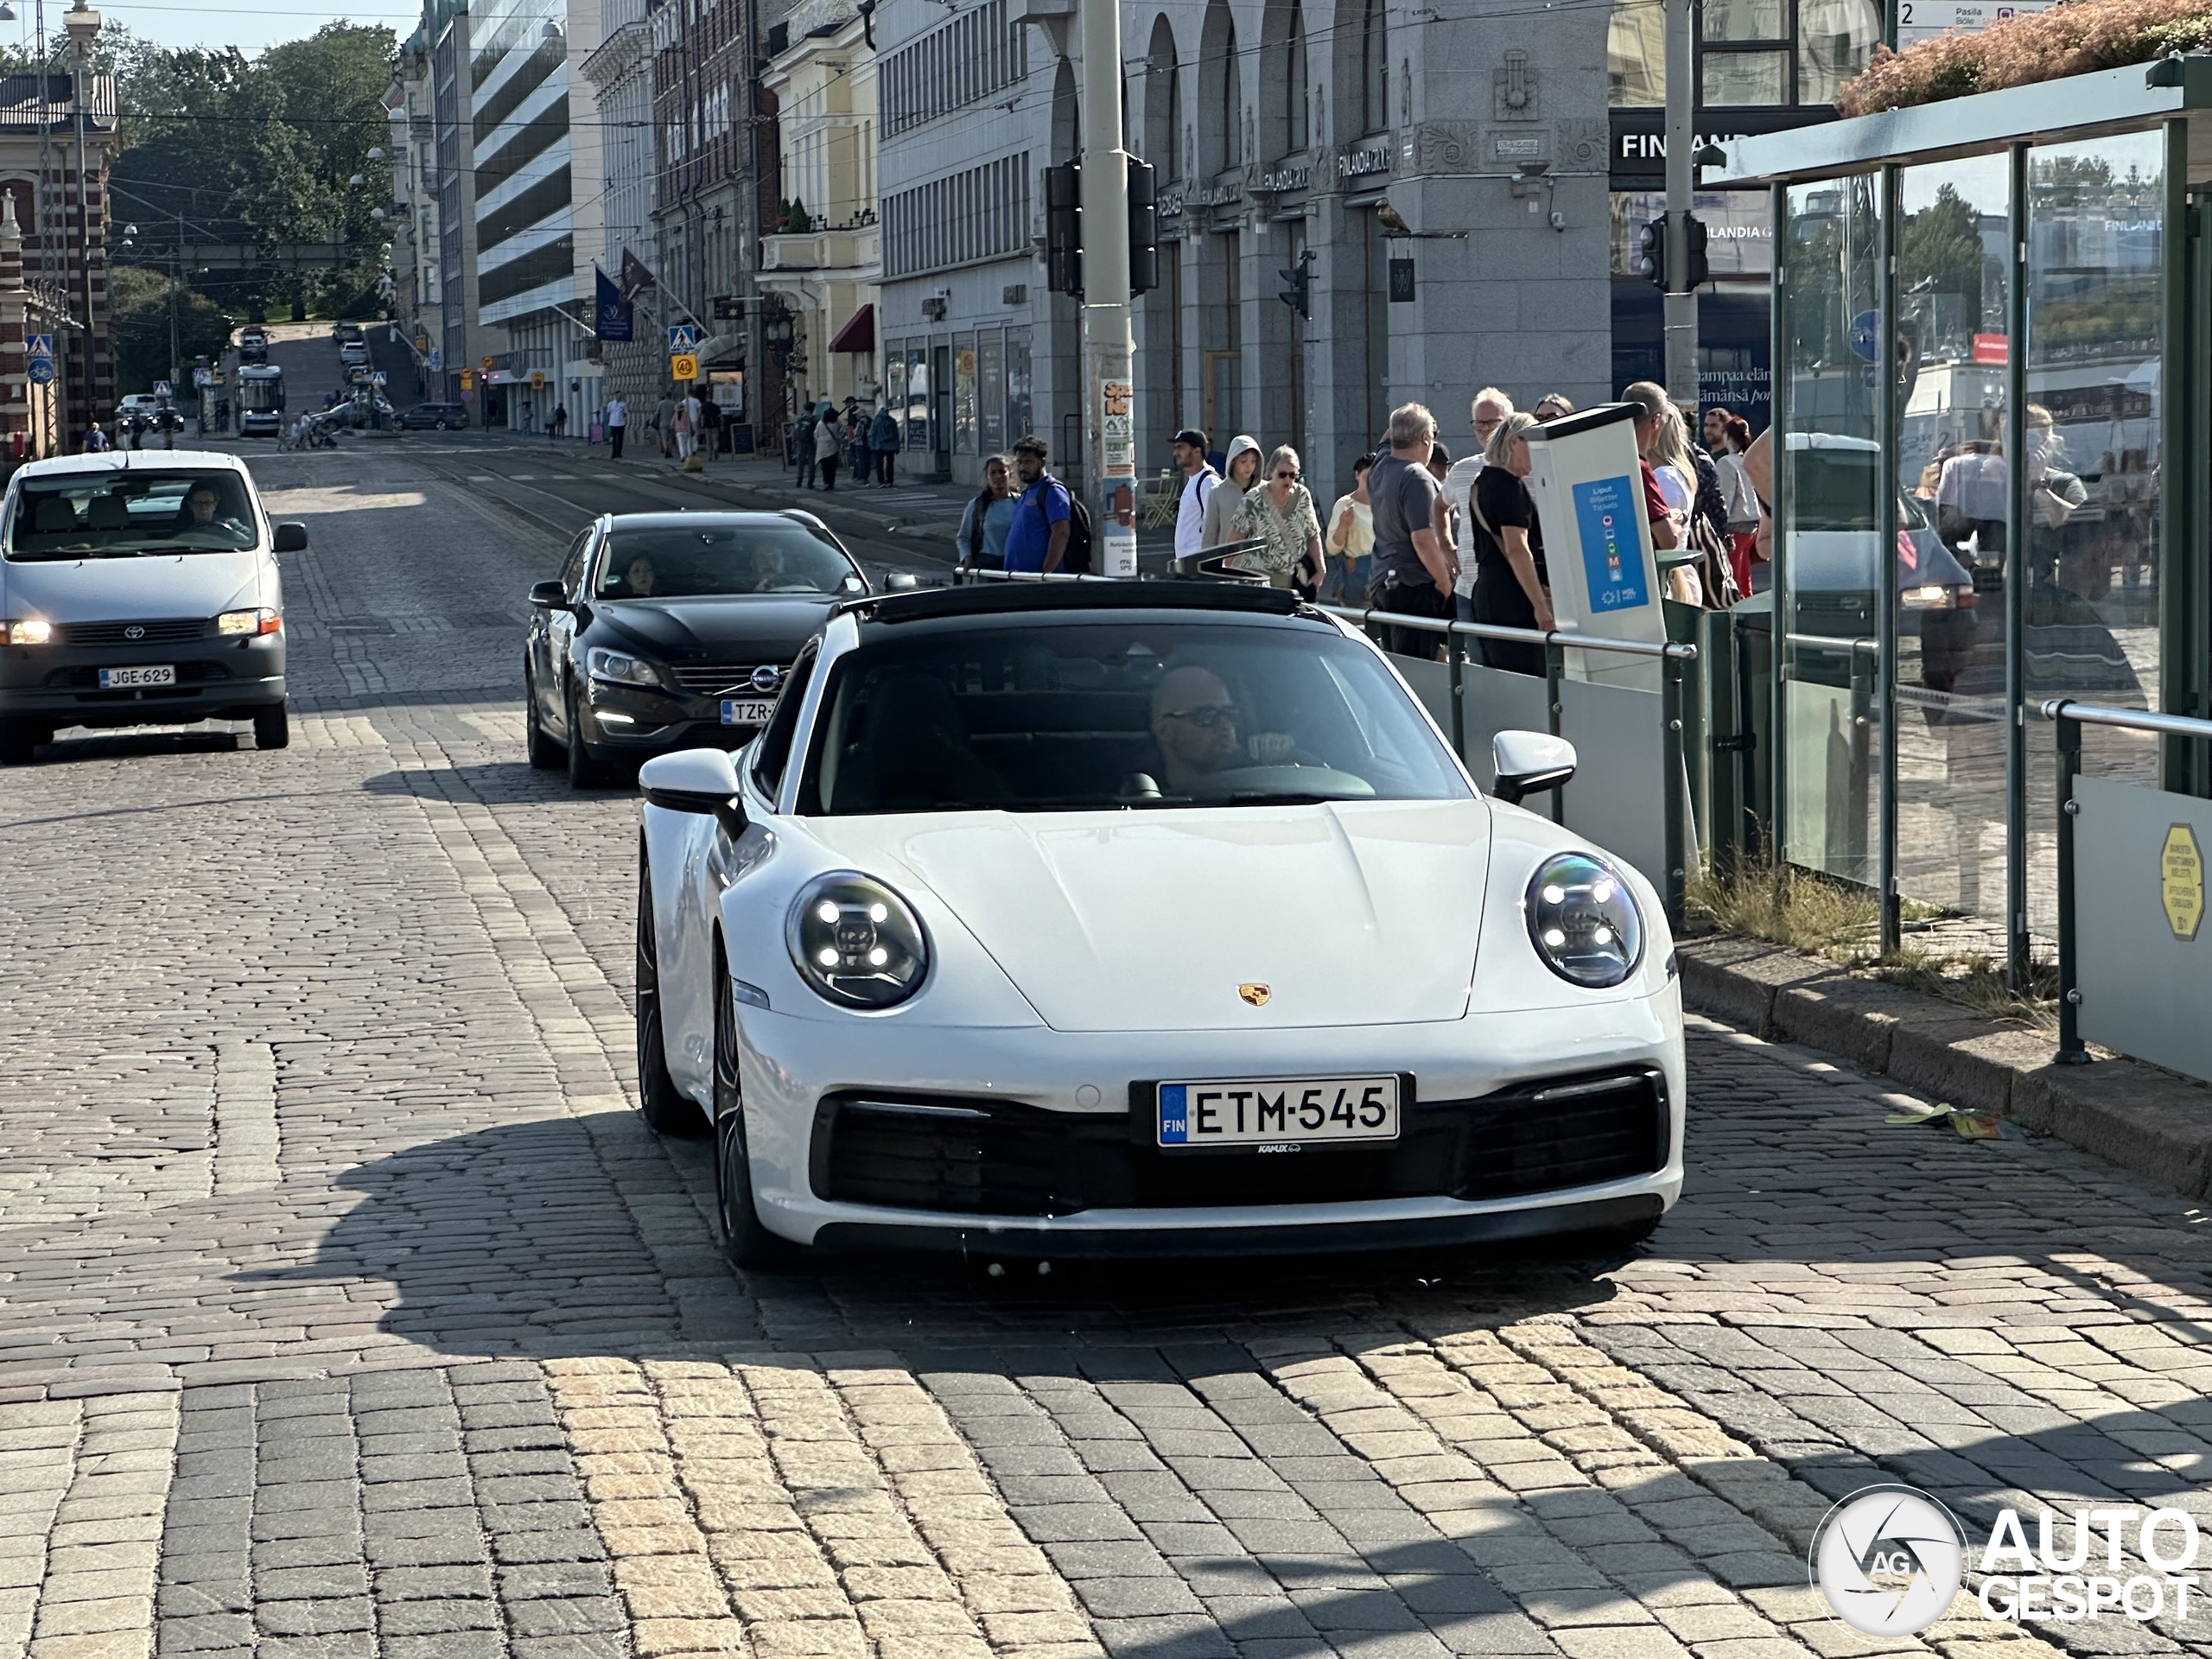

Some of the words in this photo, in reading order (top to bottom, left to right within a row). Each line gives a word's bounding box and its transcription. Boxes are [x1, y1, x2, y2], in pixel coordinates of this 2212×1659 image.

[1901, 3, 1913, 24] 2
[1955, 8, 1982, 16] Pasila
[680, 361, 690, 372] 40
[1592, 486, 1612, 495] Liput
[112, 669, 171, 684] JGE-629
[735, 703, 775, 720] TZR-
[1197, 1087, 1386, 1134] ETM-545
[1163, 1120, 1185, 1132] FIN
[1258, 1144, 1288, 1154] KAMUX
